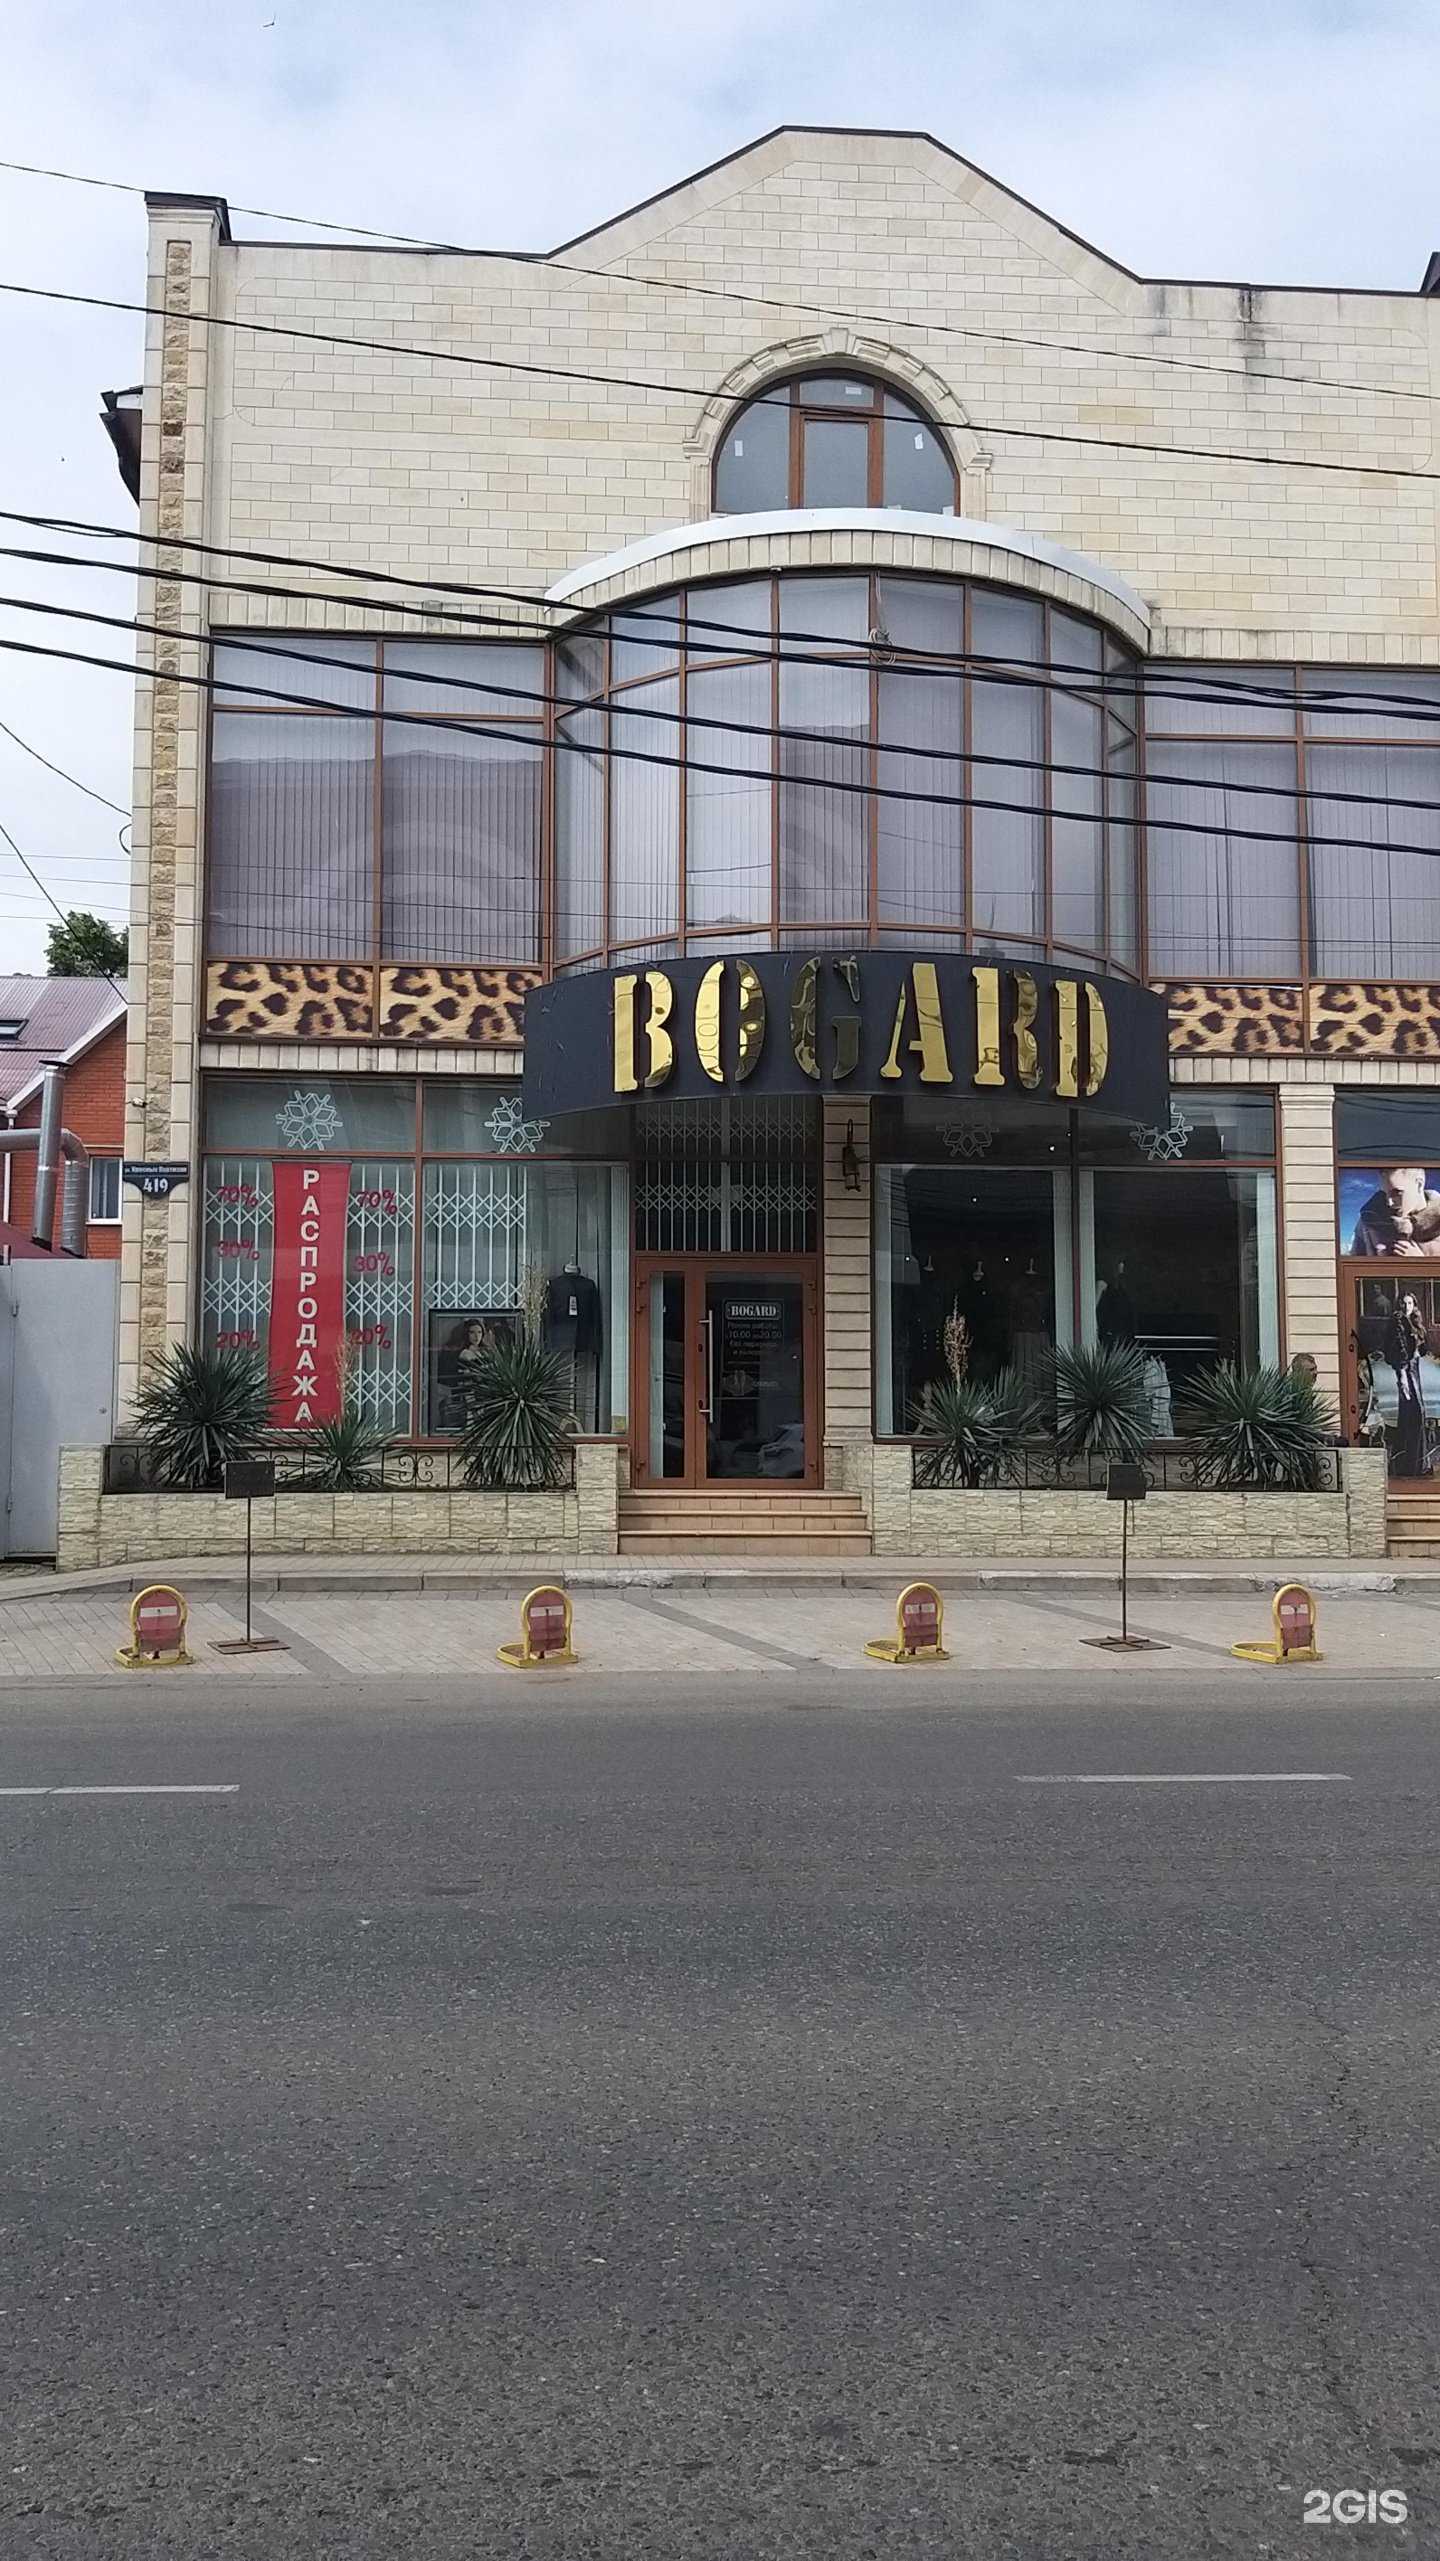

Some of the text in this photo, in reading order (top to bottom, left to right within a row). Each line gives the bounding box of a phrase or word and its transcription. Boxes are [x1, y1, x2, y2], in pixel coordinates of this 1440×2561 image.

[613, 955, 1109, 1098] BOGARD
[143, 1178, 169, 1193] 419
[354, 1252, 396, 1276] 30%
[291, 1169, 320, 1423] РАСПРОДАЖА
[731, 1305, 777, 1316] BOGARD
